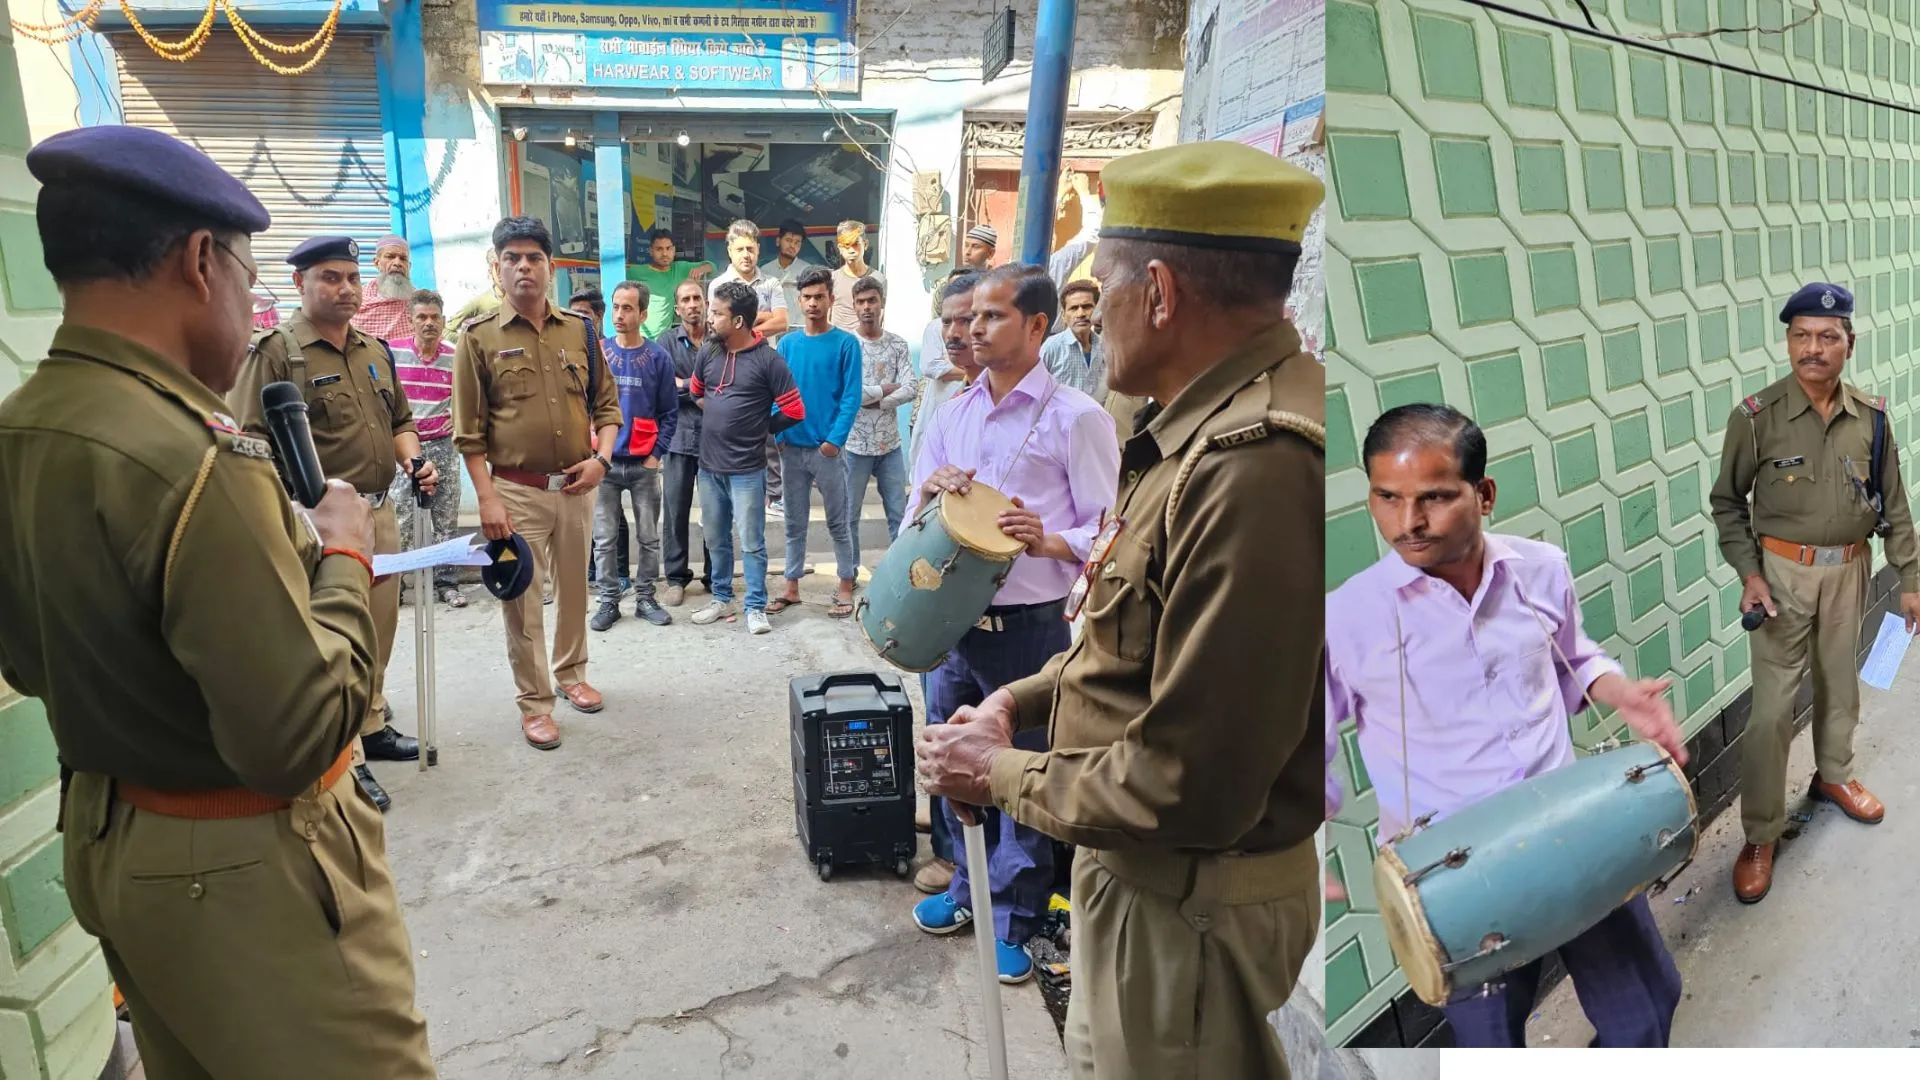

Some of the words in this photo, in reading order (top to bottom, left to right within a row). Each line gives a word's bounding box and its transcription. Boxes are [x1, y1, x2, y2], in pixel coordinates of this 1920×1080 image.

[552, 12, 579, 26] Phone,
[580, 12, 616, 27] Samsung,
[618, 13, 640, 28] Oppo,
[642, 14, 661, 28] Vivo,
[593, 64, 671, 79] HARWEAR
[674, 64, 686, 81] &
[689, 66, 771, 81] SOFTWEAR
